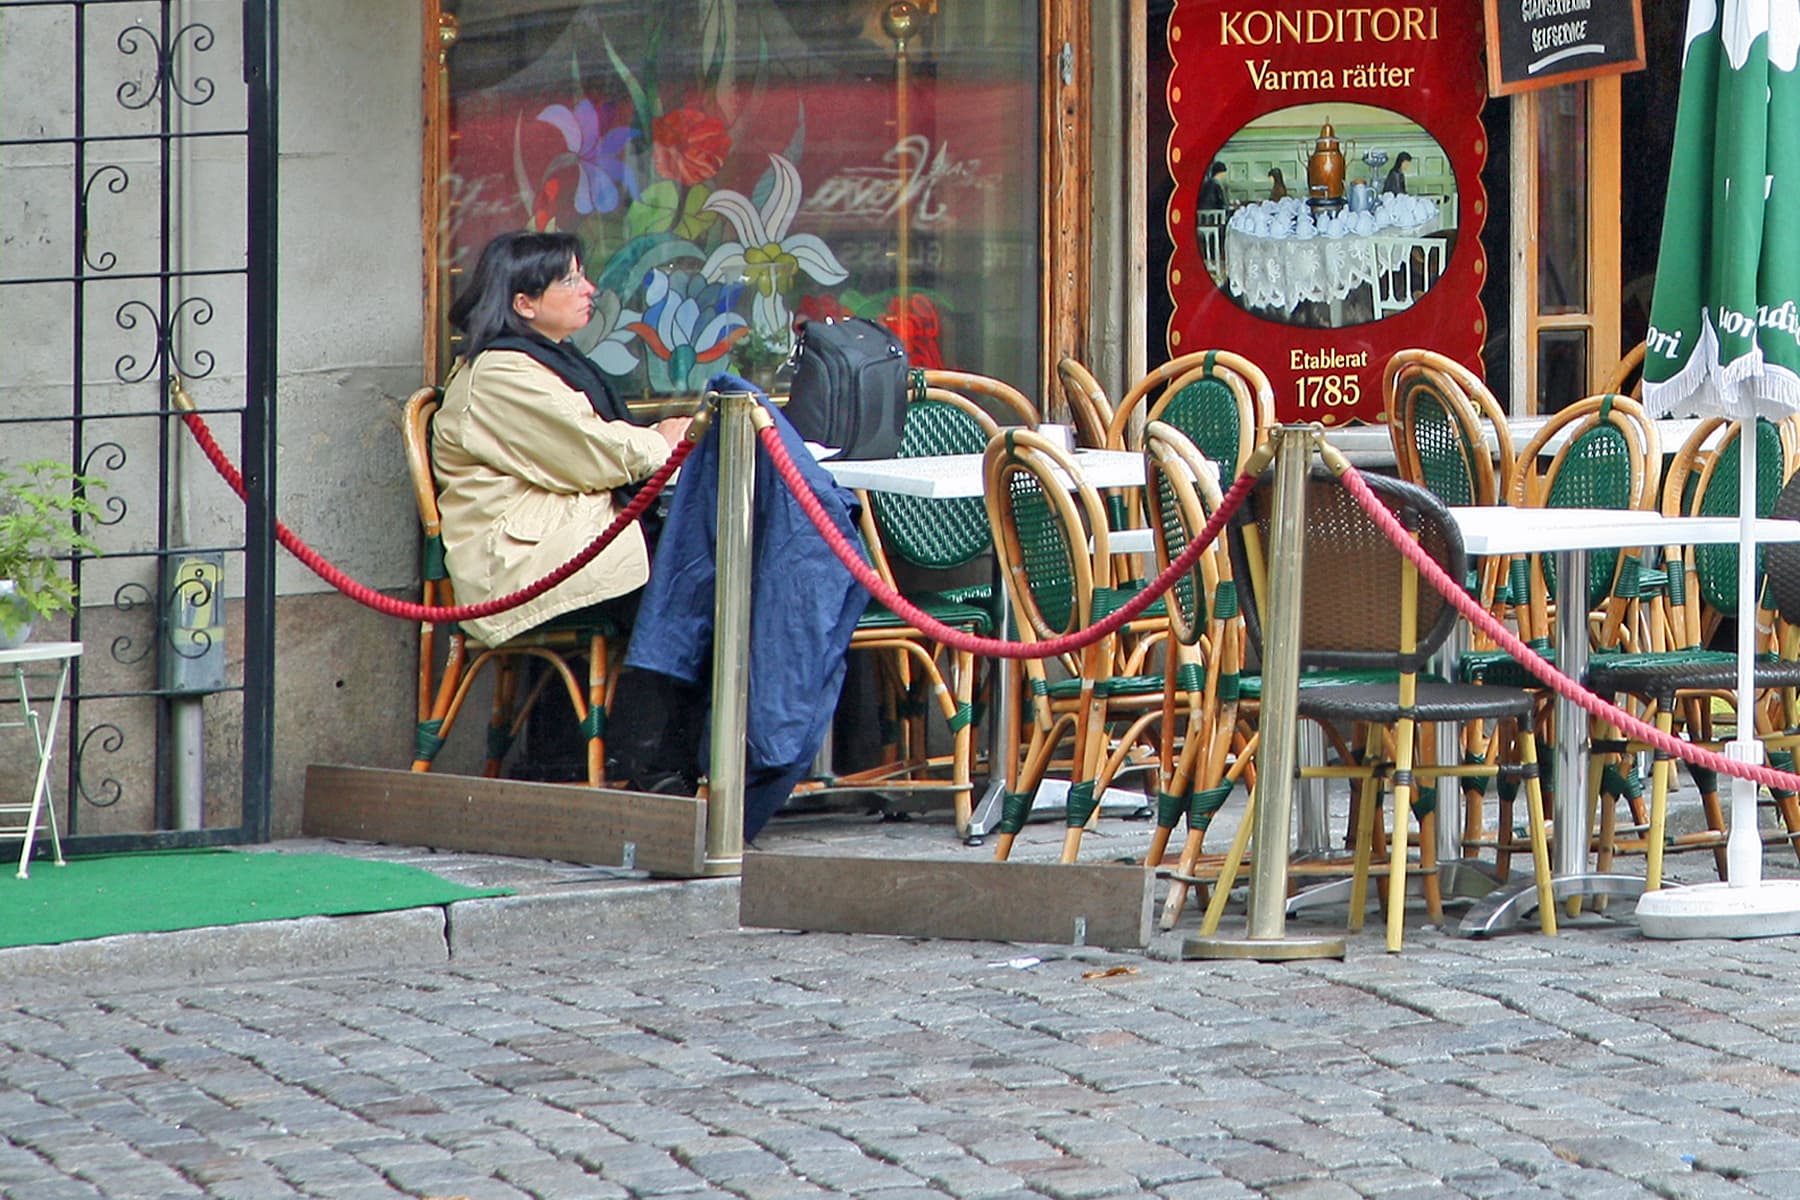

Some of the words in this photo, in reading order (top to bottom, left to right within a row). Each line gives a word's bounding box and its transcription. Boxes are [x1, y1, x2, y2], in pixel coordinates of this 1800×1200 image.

[1219, 4, 1441, 46] KONDITORI
[1245, 59, 1335, 92] Varma
[1342, 60, 1416, 89] rätter
[1289, 349, 1369, 371] Etablerat
[1294, 375, 1362, 410] 1785
